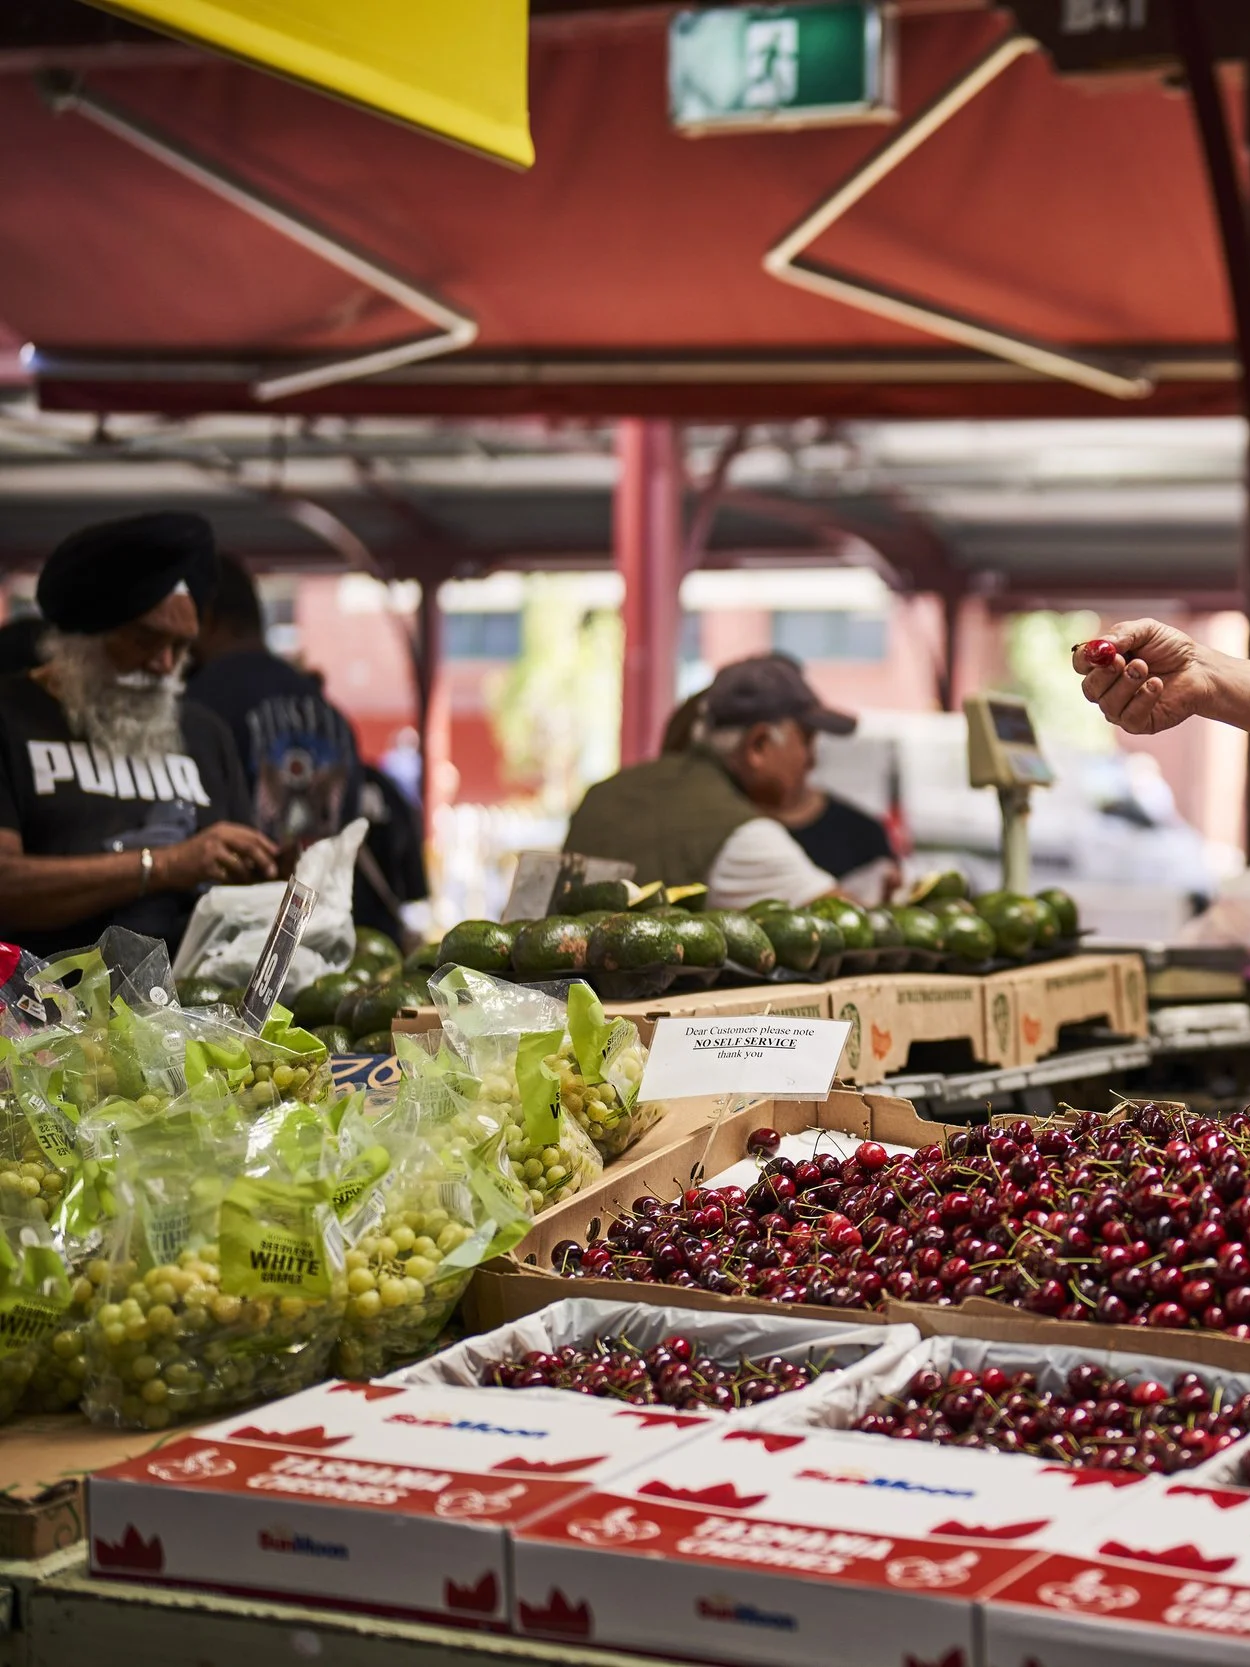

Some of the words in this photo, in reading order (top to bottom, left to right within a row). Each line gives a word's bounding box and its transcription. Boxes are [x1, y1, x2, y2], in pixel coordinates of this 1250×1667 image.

[27, 740, 210, 806] PUMA
[685, 1026, 708, 1036] Dear
[709, 1026, 758, 1036] Customers
[760, 1025, 791, 1038] please
[793, 1027, 815, 1037] note
[693, 1039, 711, 1049] NO
[713, 1038, 742, 1048] SELF
[744, 1037, 798, 1049] SERVICE
[717, 1050, 742, 1059] thank
[744, 1051, 764, 1060] you
[250, 1249, 321, 1277] WHITE
[270, 1455, 453, 1492] TASMANIA
[258, 1528, 350, 1561] SunMoon
[694, 1516, 894, 1560] TASMANIA
